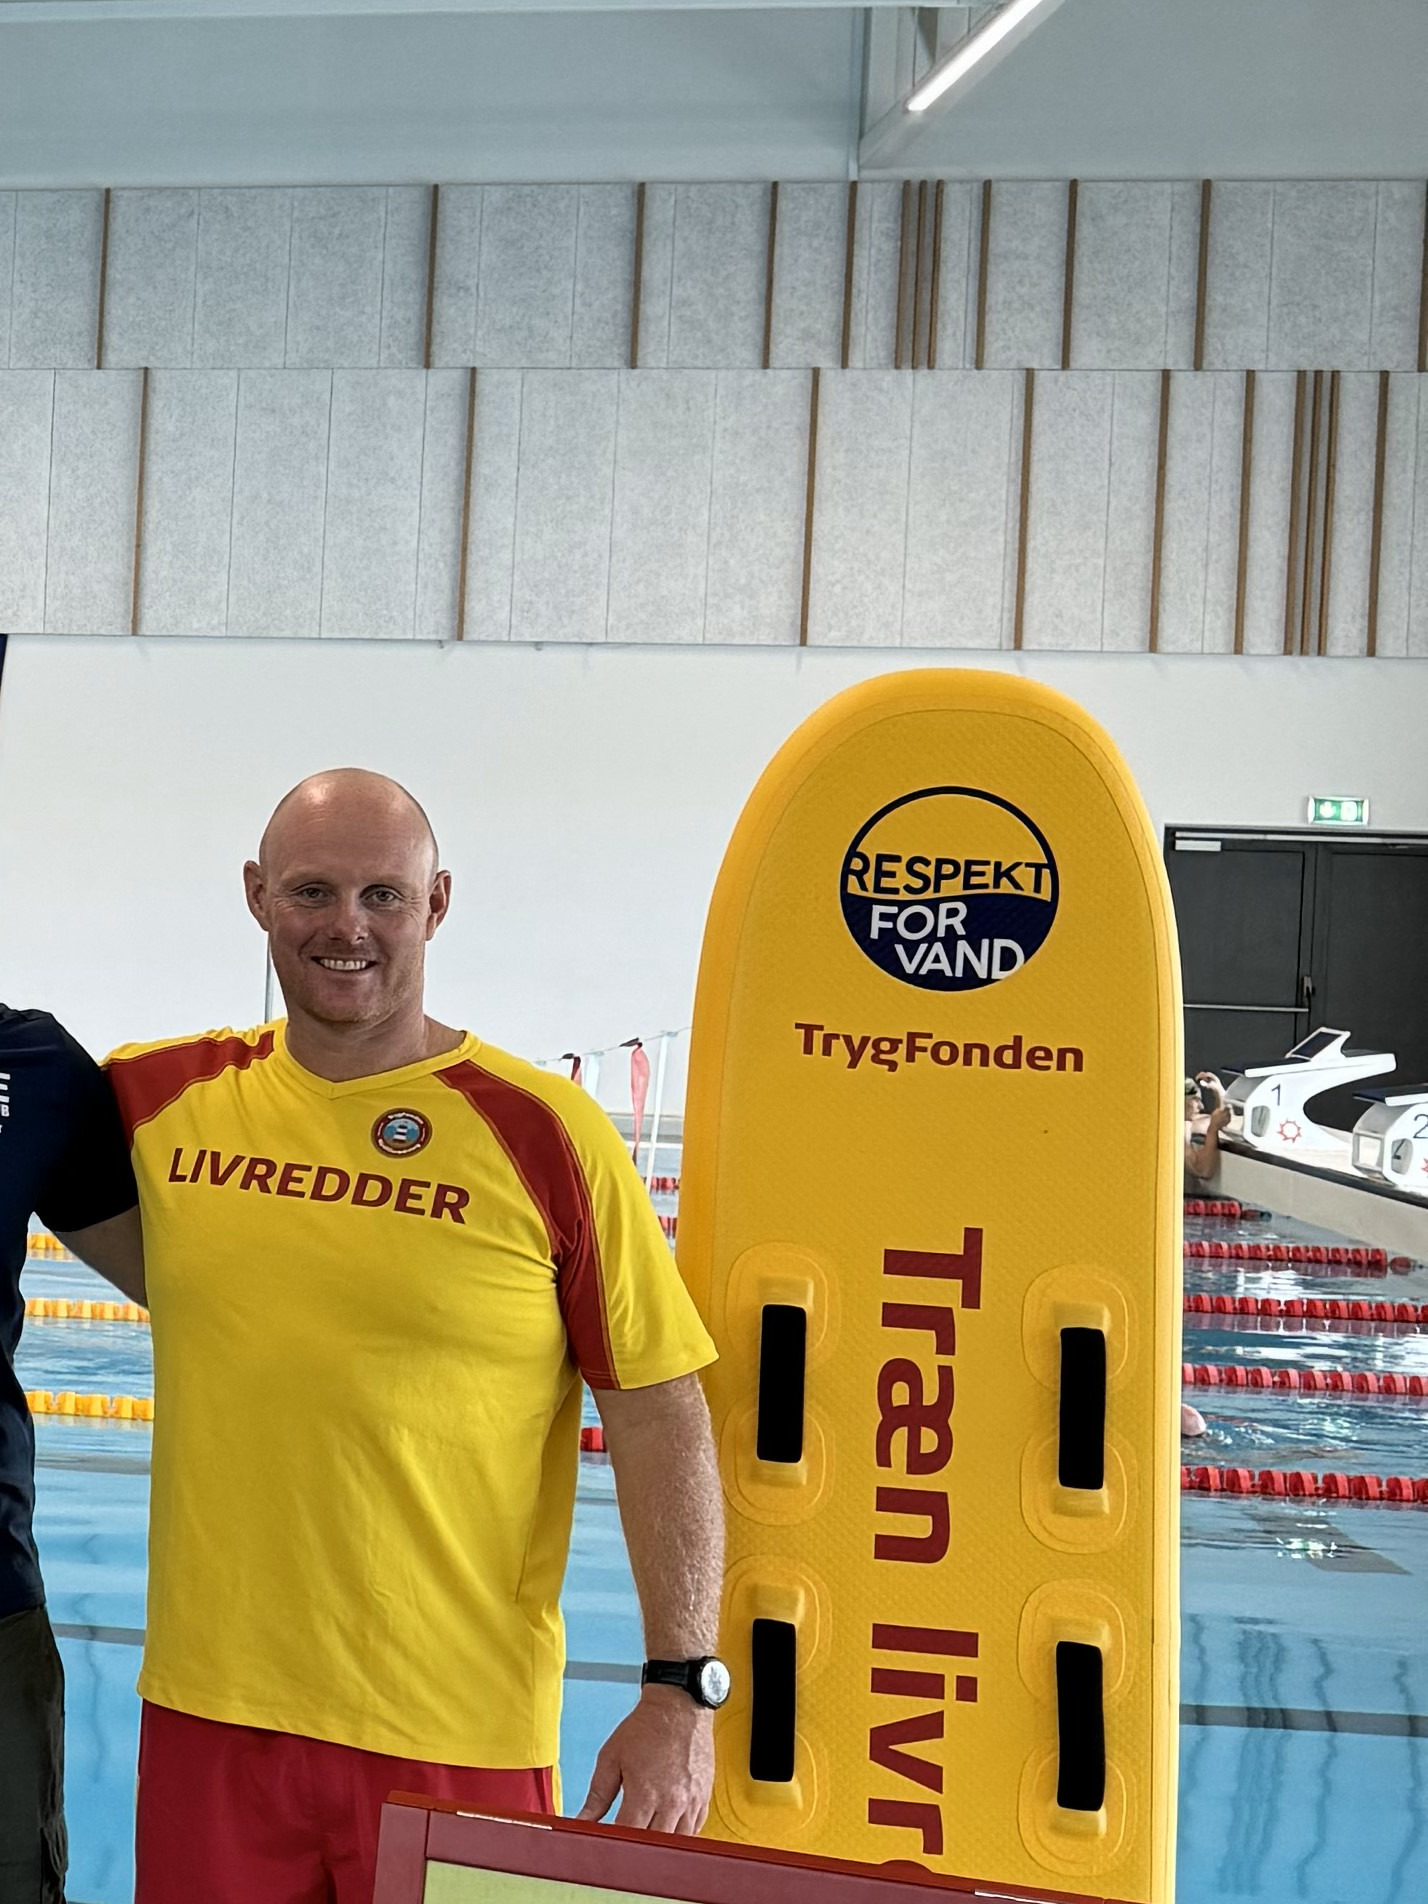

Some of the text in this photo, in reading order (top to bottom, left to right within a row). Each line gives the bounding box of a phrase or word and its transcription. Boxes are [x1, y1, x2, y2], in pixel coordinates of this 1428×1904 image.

[845, 851, 1052, 895] RESPEKT
[870, 901, 968, 940] FOR
[894, 938, 1025, 980] VAND
[794, 1023, 1084, 1072] TrygFonden
[1271, 1083, 1282, 1106] 1
[1412, 1113, 1428, 1139] 2
[167, 1147, 471, 1225] LIVREDDER
[872, 1227, 982, 1564] Træn
